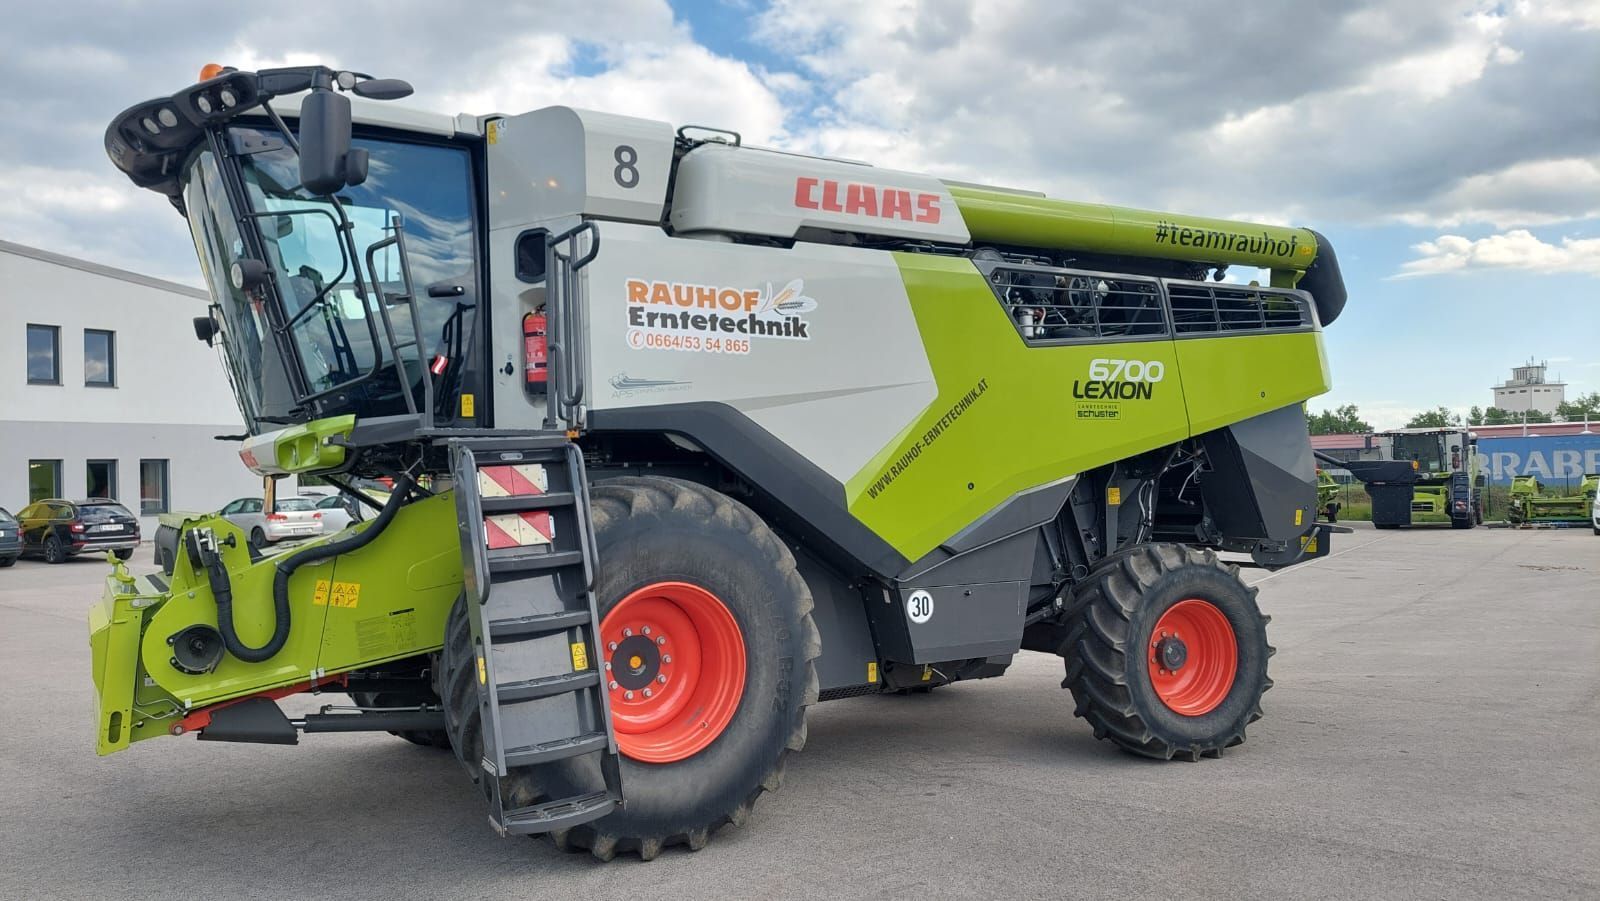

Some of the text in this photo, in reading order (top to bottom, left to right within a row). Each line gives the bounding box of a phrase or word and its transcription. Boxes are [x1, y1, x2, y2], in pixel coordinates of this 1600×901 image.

[613, 144, 640, 189] 8
[795, 176, 941, 224] CLAAS
[1155, 220, 1298, 258] #teamrauhof
[627, 280, 760, 311] RAUHOF
[628, 306, 808, 338] Erntetechnik
[646, 333, 749, 352] 0664/53 54 865
[1088, 358, 1165, 383] 6700
[1072, 380, 1153, 400] LEXION
[1077, 410, 1119, 418] schuster
[867, 378, 989, 500] WWW.RAUHOF-ERNTETECHNIK.AT
[911, 596, 930, 618] 30
